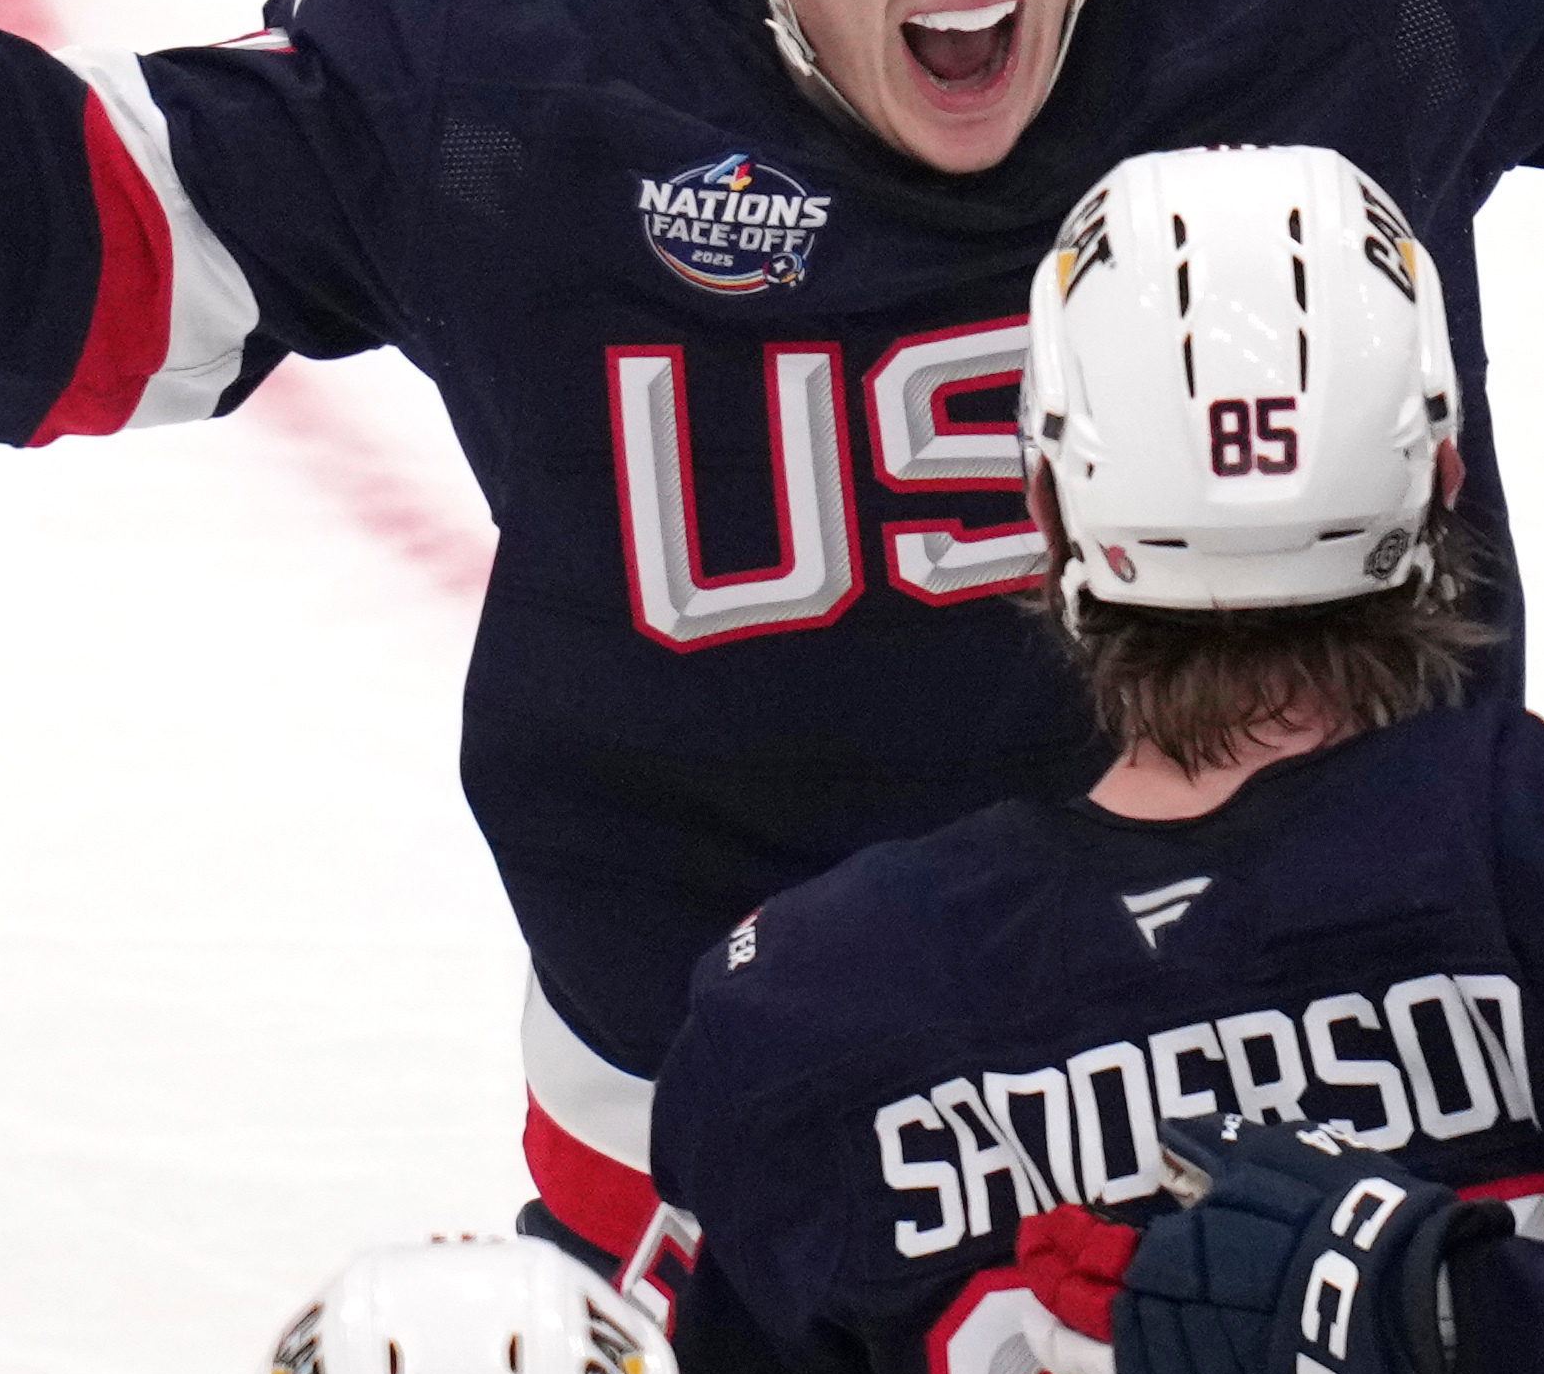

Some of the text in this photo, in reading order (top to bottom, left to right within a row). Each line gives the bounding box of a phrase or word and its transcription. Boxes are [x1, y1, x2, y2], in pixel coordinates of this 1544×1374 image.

[639, 178, 832, 228] NATIONS
[653, 212, 808, 253] FACE-OFF
[691, 248, 734, 268] 2025
[1208, 396, 1298, 478] 85
[604, 312, 1046, 654] US
[875, 972, 1542, 1259] SANDERSON
